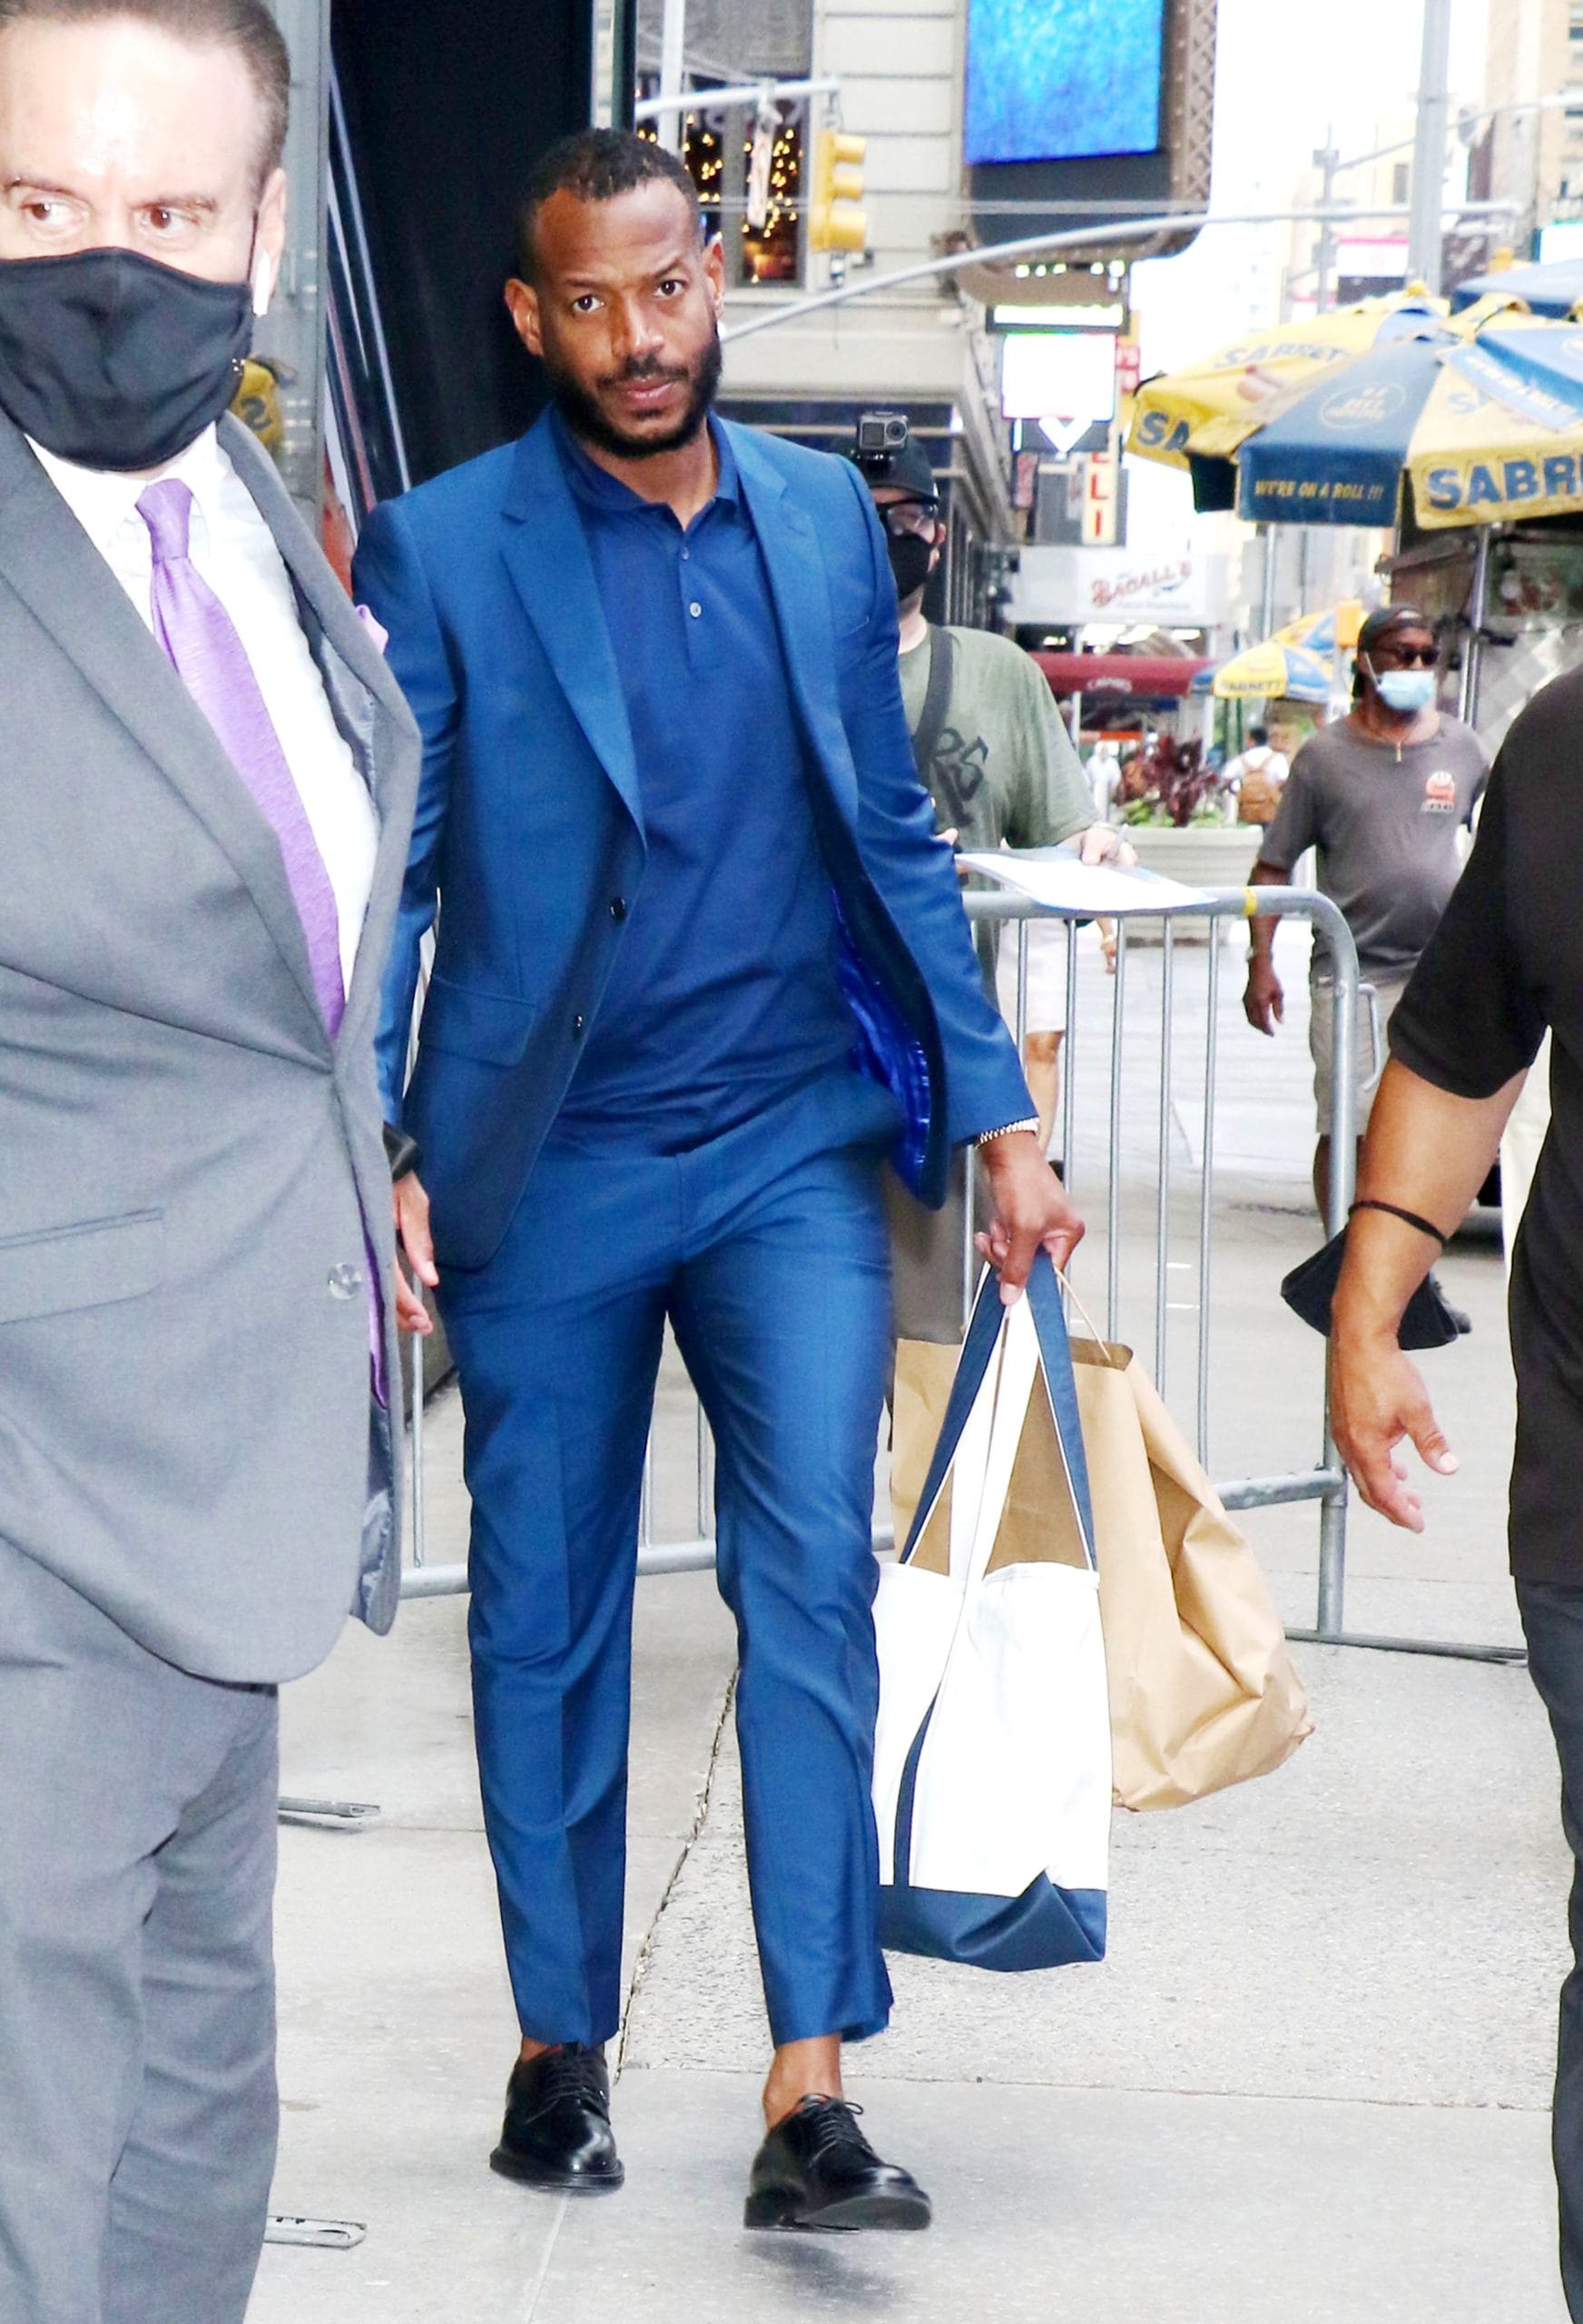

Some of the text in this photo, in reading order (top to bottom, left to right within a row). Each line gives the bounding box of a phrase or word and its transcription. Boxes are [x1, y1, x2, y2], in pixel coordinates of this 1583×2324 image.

[1255, 479, 1295, 497] WE'RE
[1298, 481, 1316, 498] ON
[1318, 482, 1330, 498] A
[1332, 482, 1362, 499] ROLL
[1428, 454, 1583, 510] SABR
